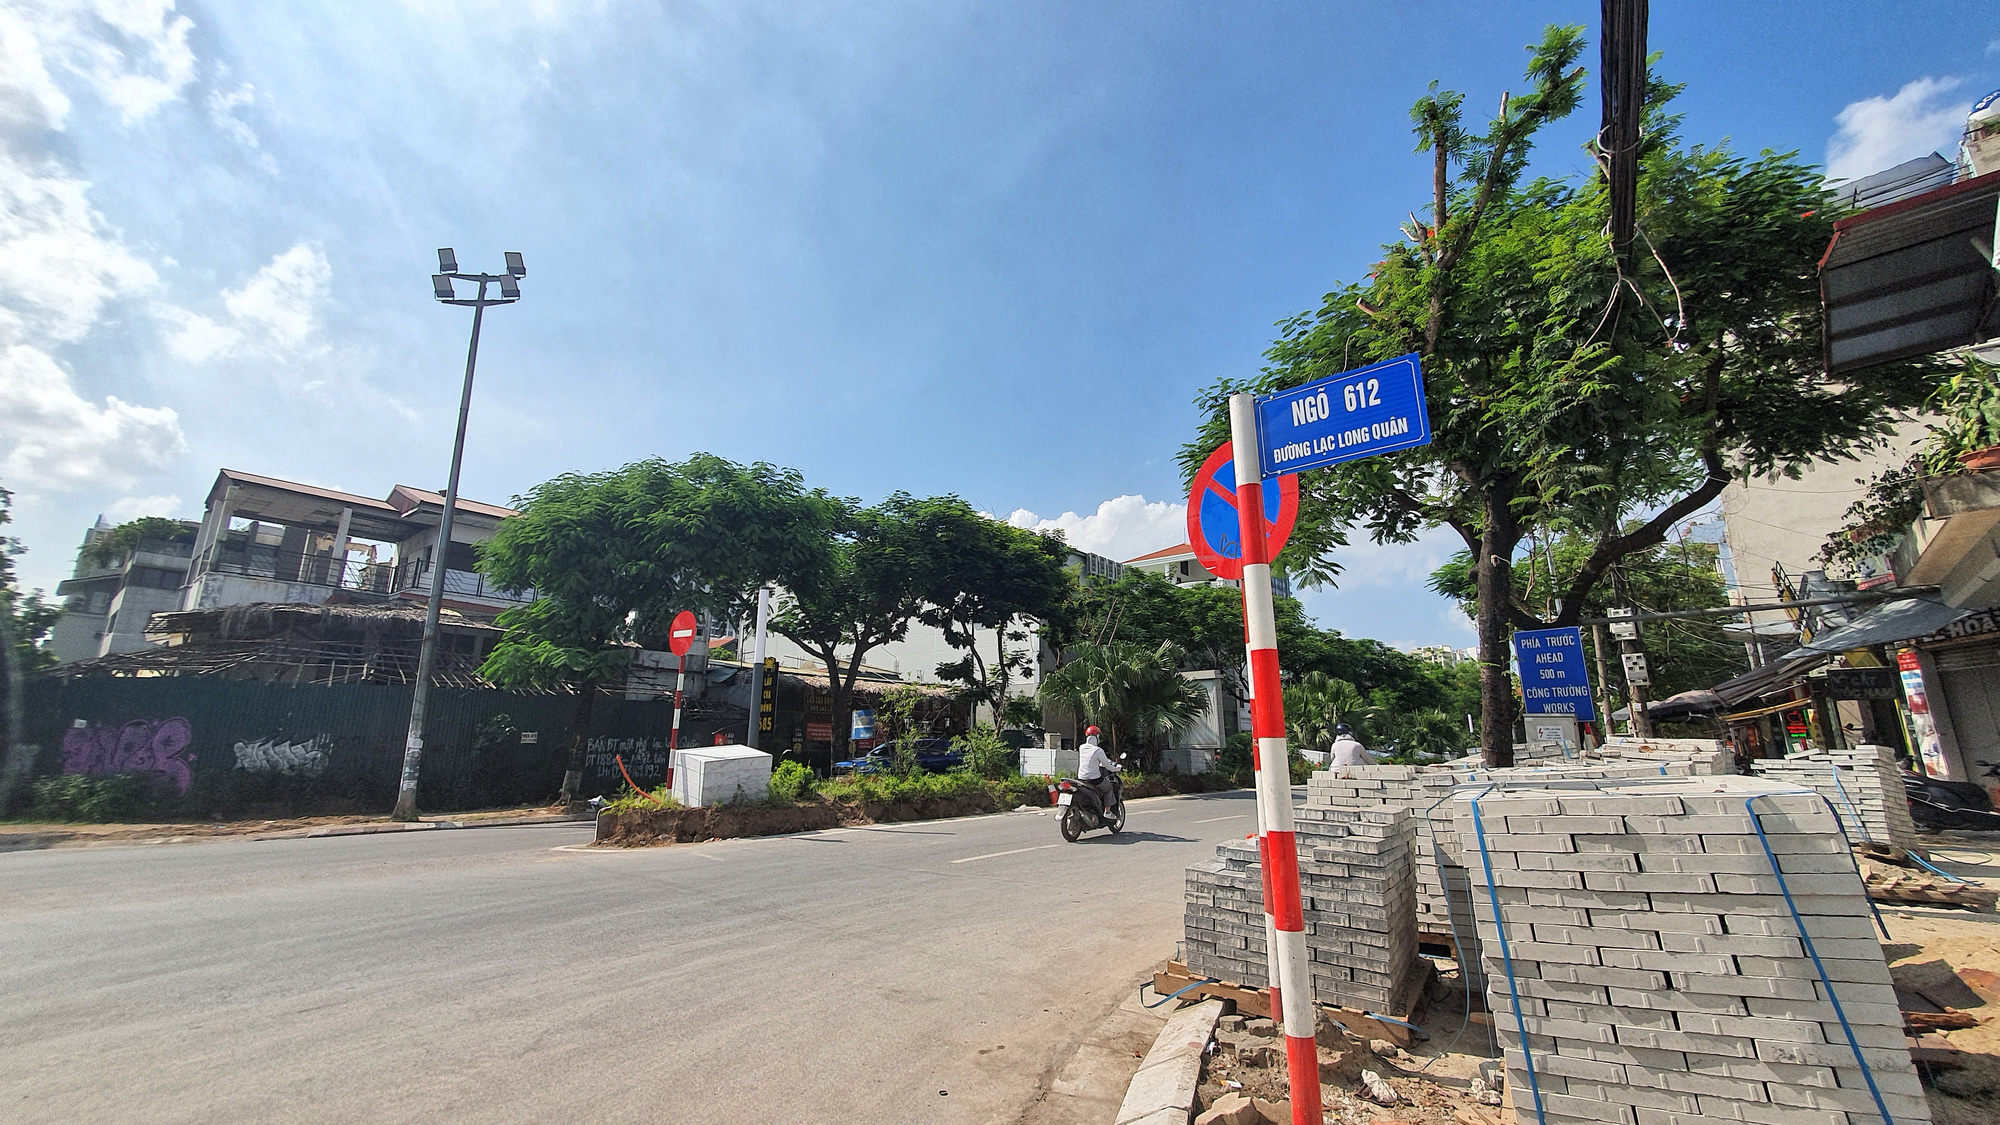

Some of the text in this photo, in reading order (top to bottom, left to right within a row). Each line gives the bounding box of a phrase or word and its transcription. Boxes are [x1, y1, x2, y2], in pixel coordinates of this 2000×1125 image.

[1291, 378, 1381, 427] NGÕ 612
[1273, 415, 1409, 464] ĐƯỜNG LẠC LONG QUÂN
[1520, 633, 1575, 649] PHÍA TRƯỚC
[1536, 652, 1564, 664] AHEAD
[1540, 668, 1566, 680] 500 m
[1526, 684, 1588, 698] CÔNG TRƯỜNG
[1543, 702, 1576, 714] WORKS
